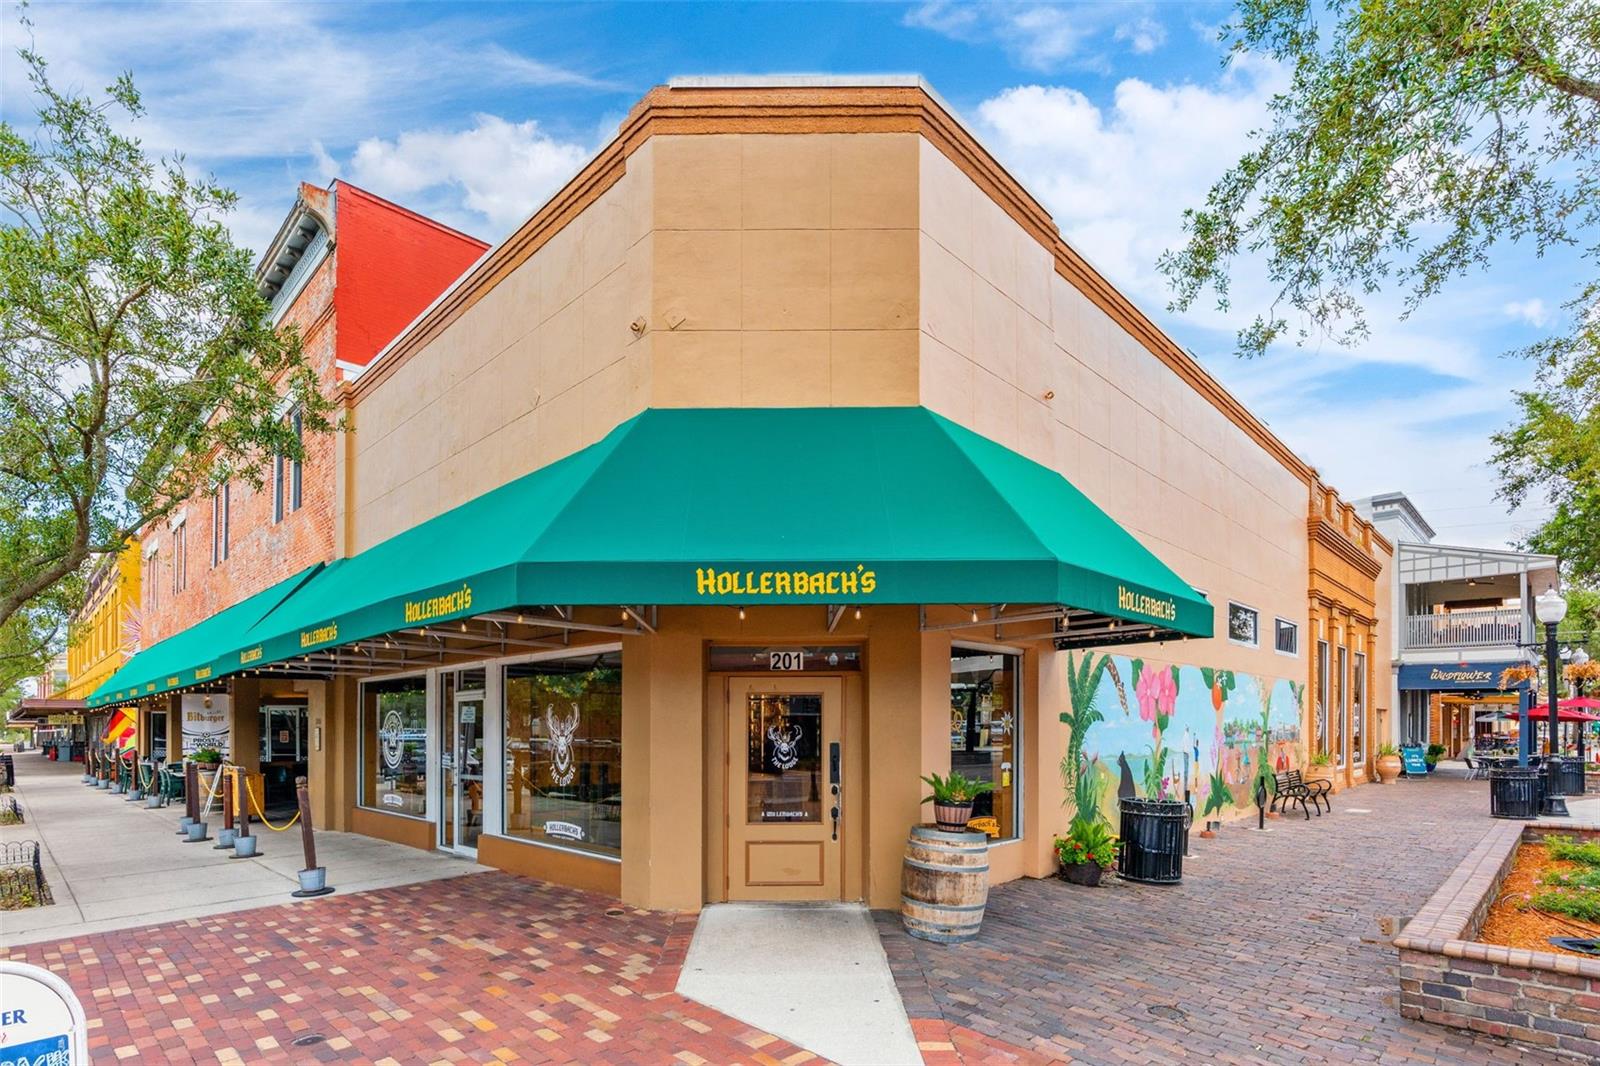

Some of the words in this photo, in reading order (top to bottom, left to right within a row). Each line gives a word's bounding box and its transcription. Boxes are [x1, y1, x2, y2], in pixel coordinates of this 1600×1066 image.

[696, 564, 876, 595] HOLLERBACH'S
[405, 583, 472, 623] HOLLERBACH'S
[1118, 585, 1176, 621] HOLLERBACH'S
[771, 653, 802, 670] 201
[1430, 669, 1493, 681] WILDFLOWER
[187, 711, 224, 723] Bitburger
